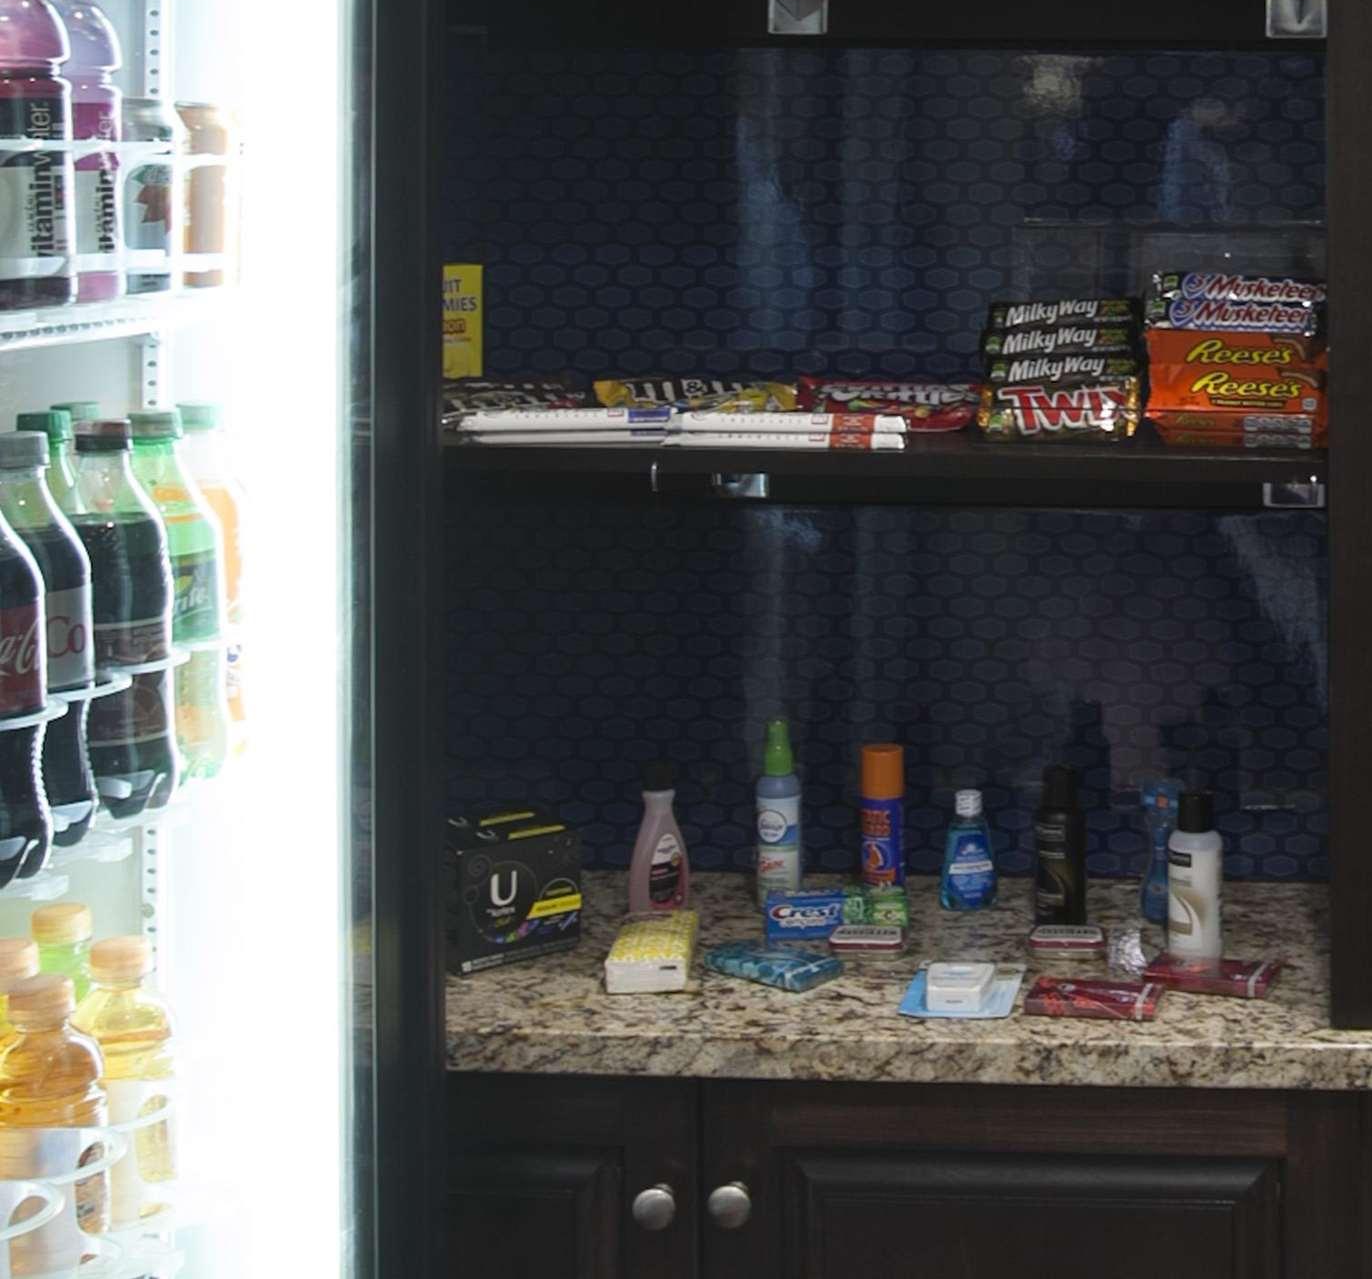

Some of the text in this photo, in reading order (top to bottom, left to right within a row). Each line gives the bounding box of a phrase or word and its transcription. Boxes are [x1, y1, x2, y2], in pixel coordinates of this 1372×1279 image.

[1004, 299, 1099, 328] Milky Way
[1001, 326, 1098, 355] Milky Way
[1184, 337, 1293, 365] Reese's
[1007, 355, 1106, 383] Milky Way
[1190, 370, 1302, 399] Reese's
[490, 869, 519, 907] U
[769, 903, 838, 919] Crest
